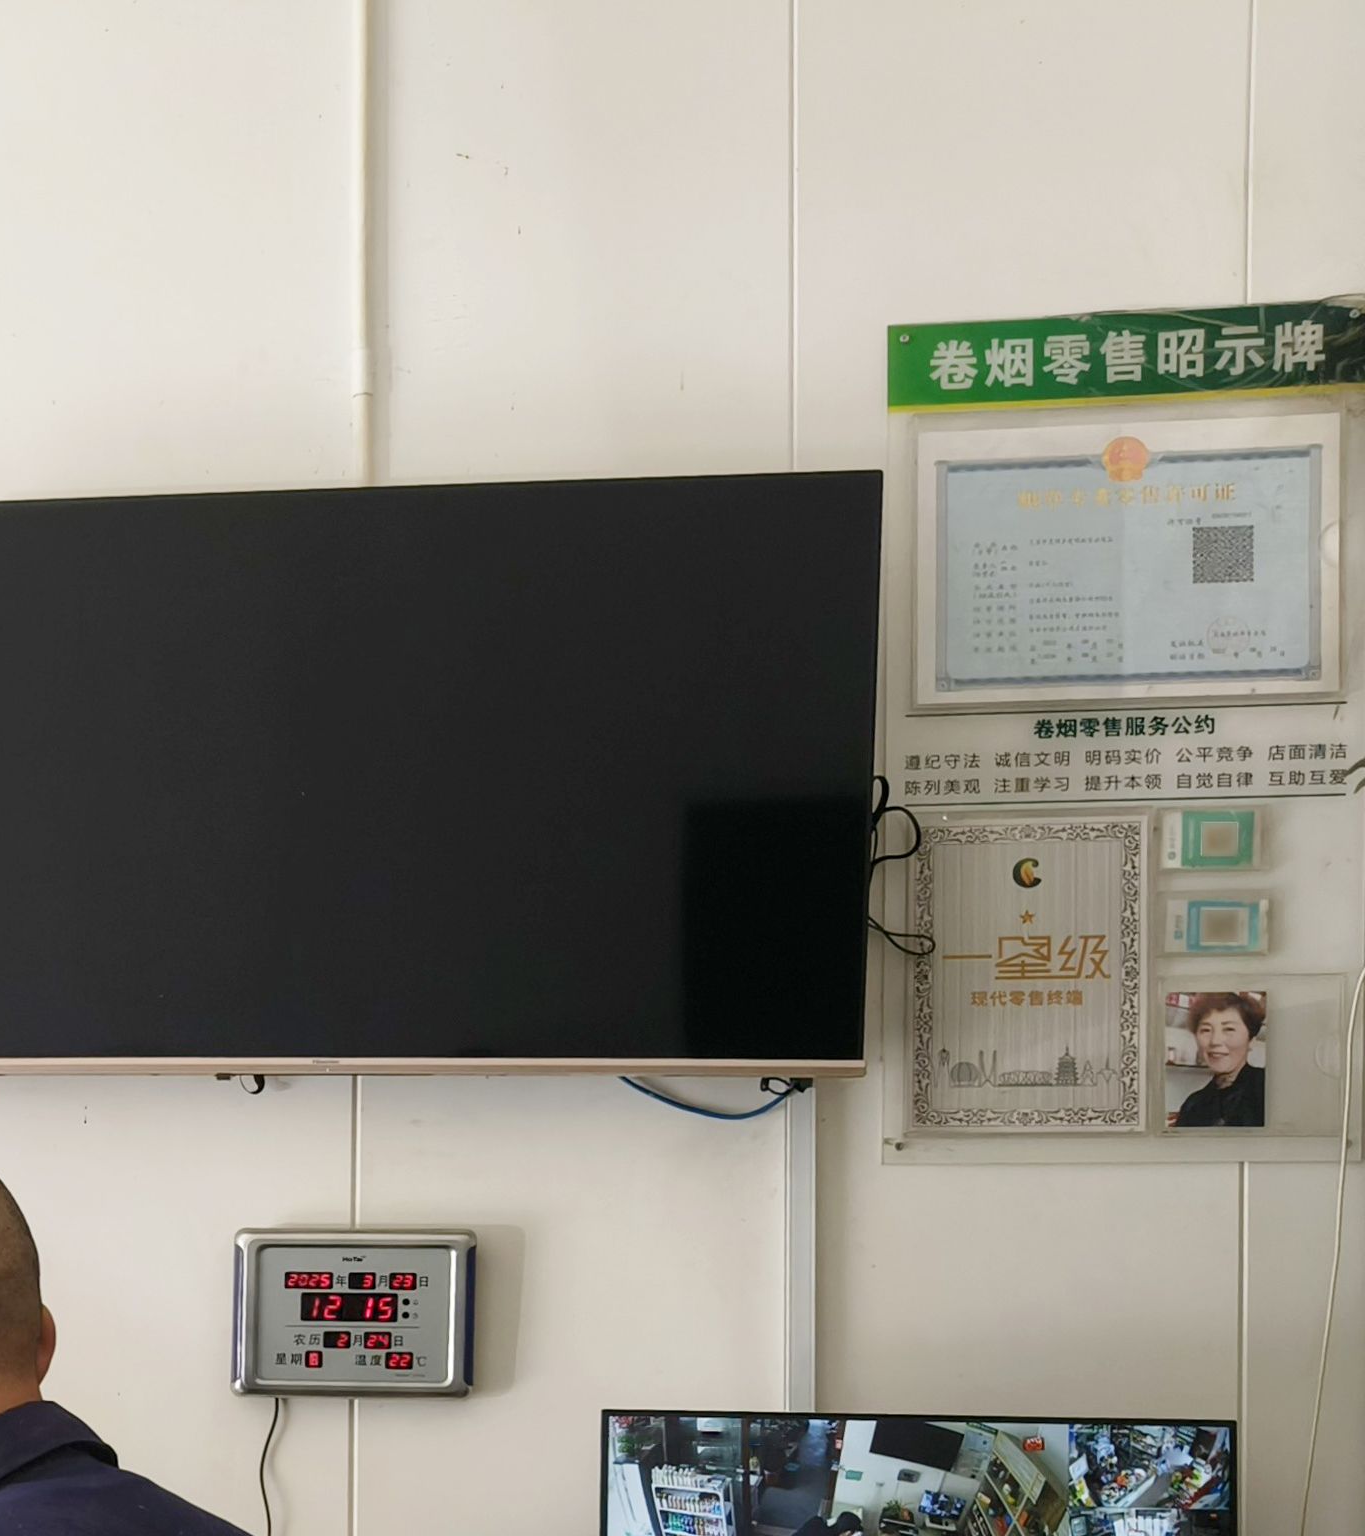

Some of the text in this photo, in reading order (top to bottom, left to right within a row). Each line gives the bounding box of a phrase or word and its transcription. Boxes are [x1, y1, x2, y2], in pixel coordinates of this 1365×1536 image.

[929, 322, 1326, 390] 卷烟零售昭示牌
[1033, 714, 1216, 739] 卷烟零售服务公约
[904, 742, 1348, 771] 遵纪守法 诚信文明 明码实价 公平竞争 店面清洁
[904, 769, 1348, 796] 陈列美观 注重学习 提升本领 自觉自律 互助互爱
[942, 933, 1111, 981] 一星级
[971, 990, 1084, 1008] 现代零售终端
[310, 1295, 393, 1319] 12 15
